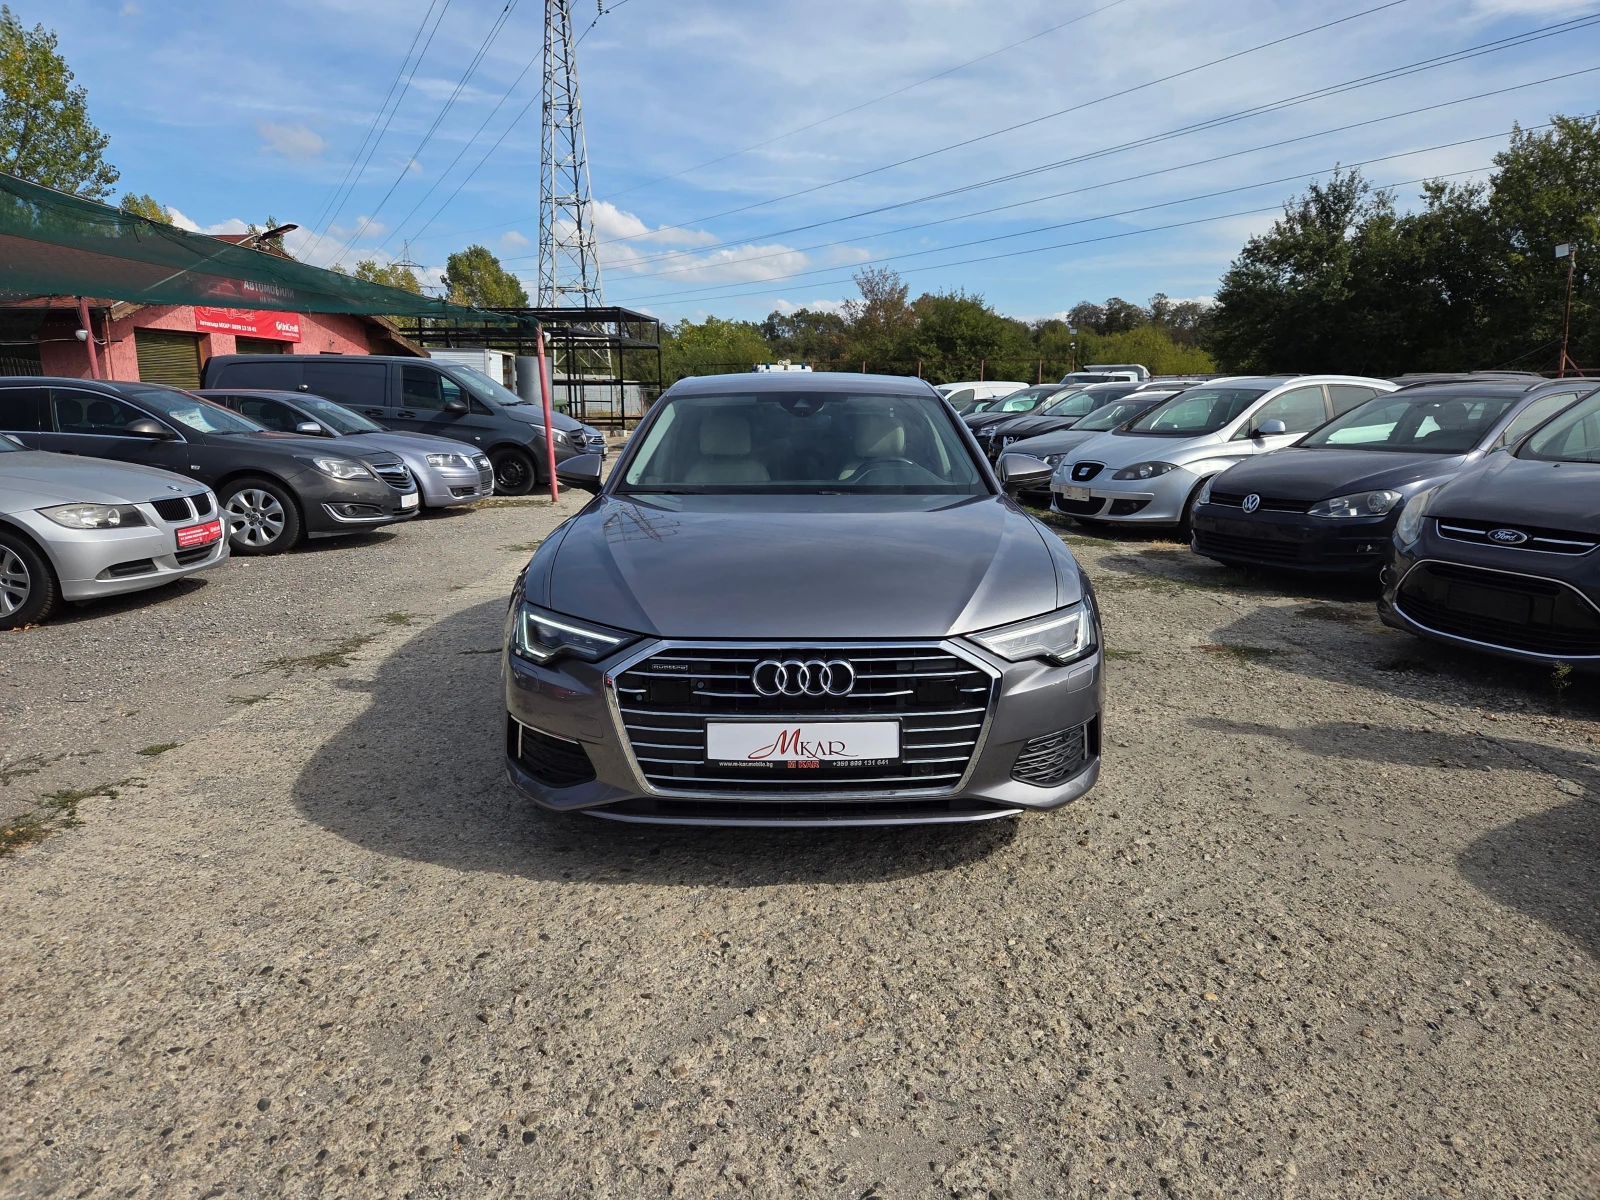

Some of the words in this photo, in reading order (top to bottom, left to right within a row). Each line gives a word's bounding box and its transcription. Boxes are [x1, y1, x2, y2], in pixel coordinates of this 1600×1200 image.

[243, 280, 295, 299] АВТОМОБИЛИ
[1494, 530, 1518, 542] Ford
[787, 760, 797, 769] M
[798, 760, 820, 769] KAR
